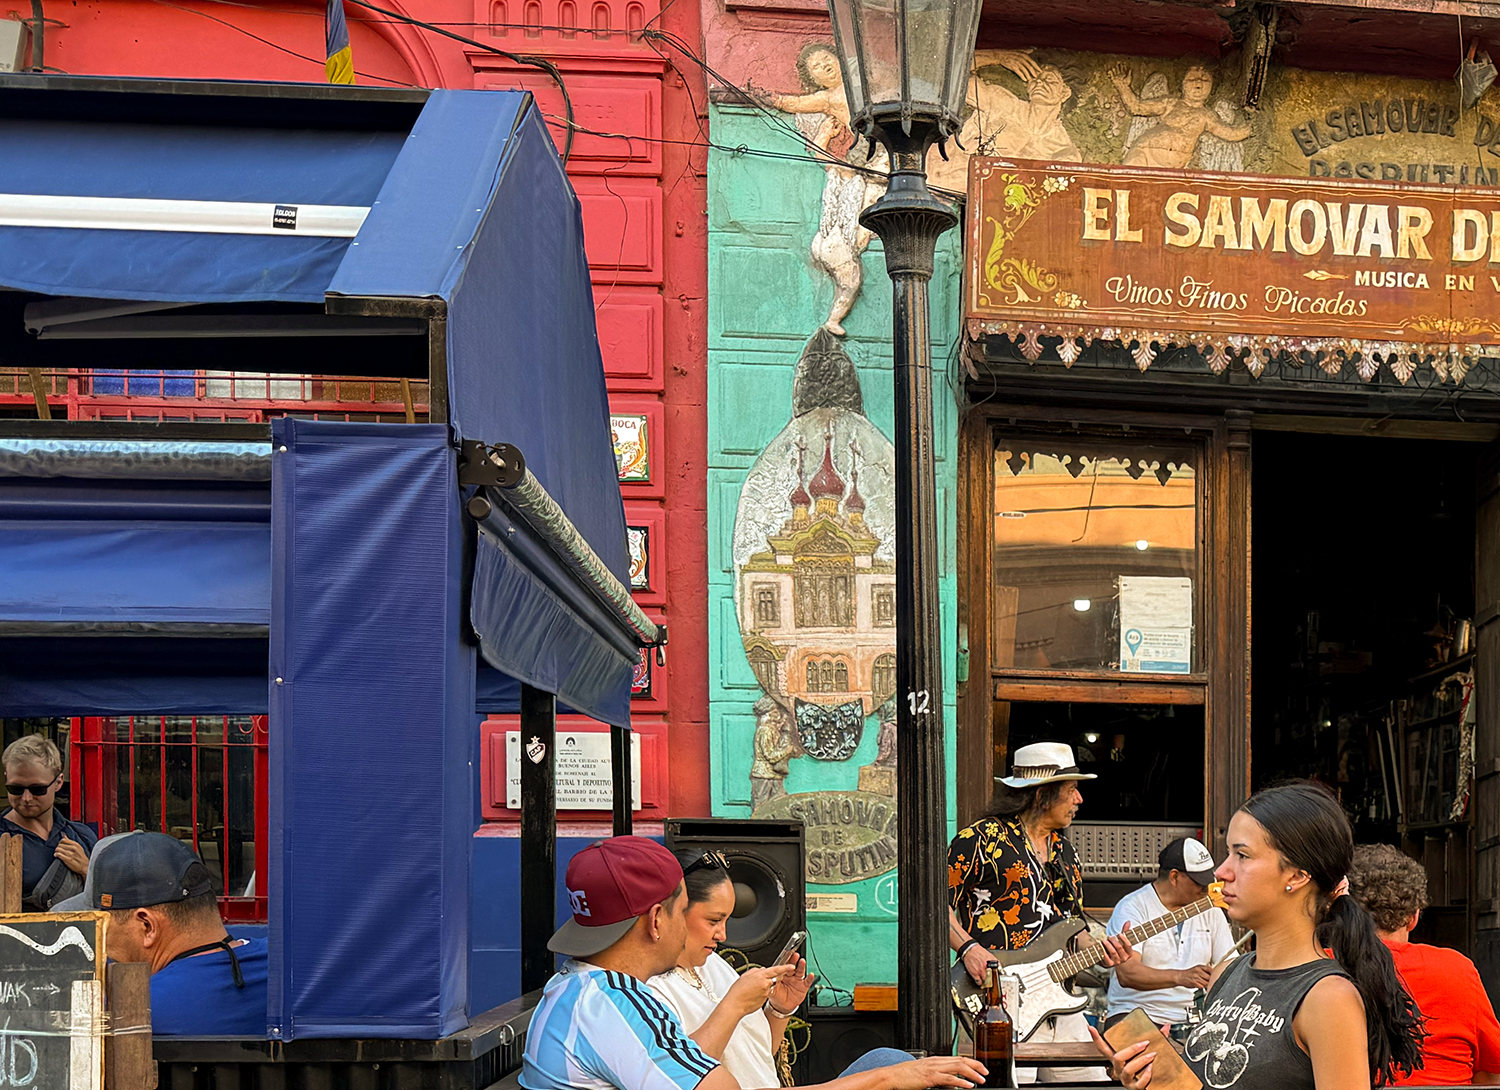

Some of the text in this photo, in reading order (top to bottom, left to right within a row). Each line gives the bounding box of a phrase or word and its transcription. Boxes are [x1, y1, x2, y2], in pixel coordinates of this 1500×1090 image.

[1291, 119, 1332, 158] EL
[1325, 97, 1462, 143] SAMOVAR
[1082, 187, 1144, 243] EL
[1164, 192, 1434, 261] SAMOVAR
[1105, 275, 1369, 317] Vinos Finos Picadas
[1354, 270, 1431, 290] MUSICA
[1444, 273, 1475, 292] EN
[907, 690, 930, 716] 12
[821, 829, 844, 846] DE
[807, 839, 898, 878] SPUTIN
[1243, 1003, 1285, 1034] Baby
